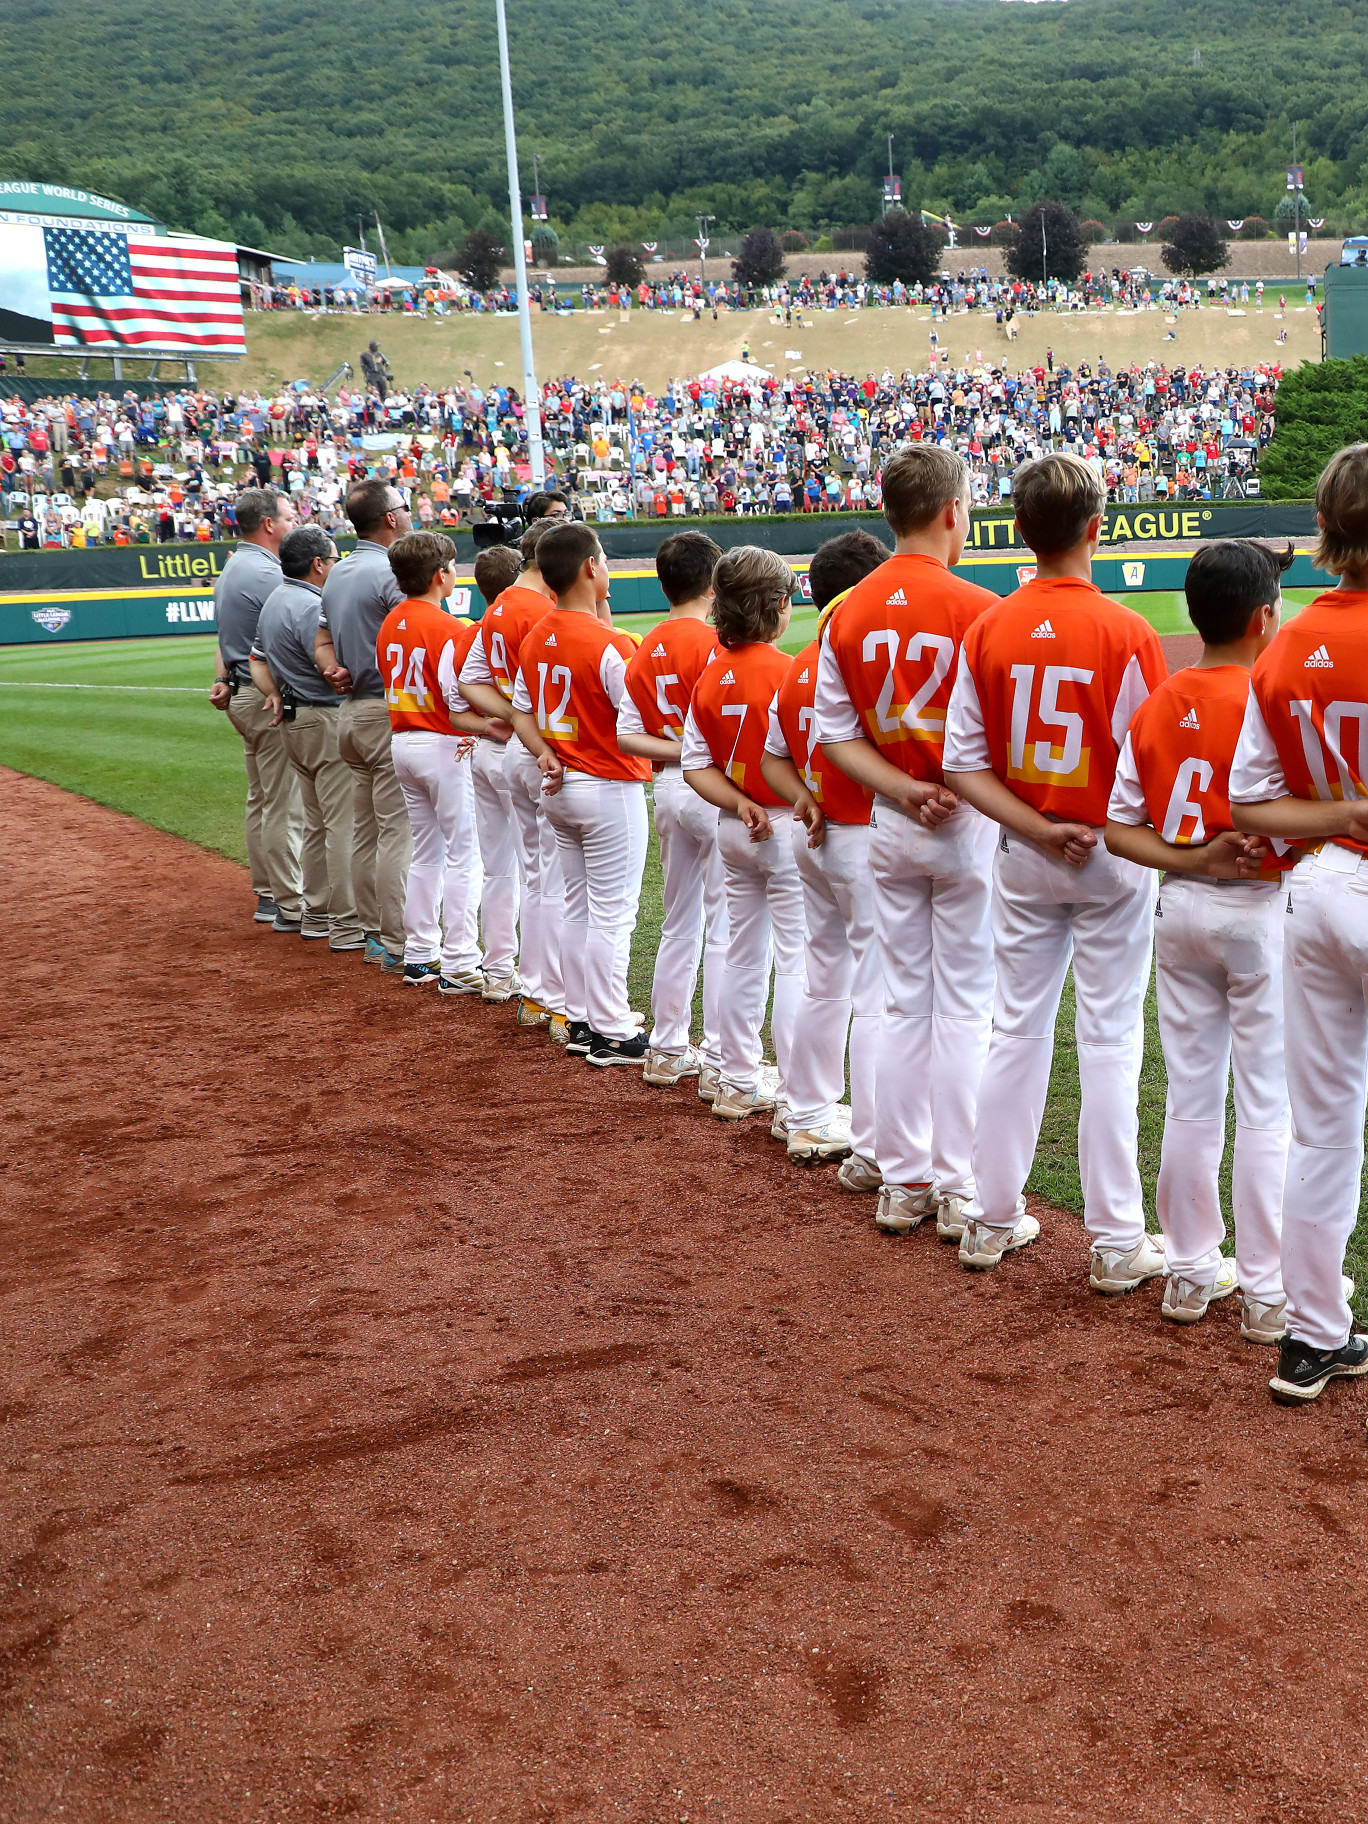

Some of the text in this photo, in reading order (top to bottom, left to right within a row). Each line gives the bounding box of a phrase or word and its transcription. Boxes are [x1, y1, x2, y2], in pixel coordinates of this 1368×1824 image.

[0, 182, 130, 218] EAGUE WORLD SERIES
[16, 214, 152, 234] FOUNDATIONS
[139, 552, 224, 579] LittleL
[1130, 566, 1138, 579] A
[166, 601, 215, 622] #LLW
[456, 592, 464, 606] J
[885, 598, 908, 606] adidas
[1030, 630, 1056, 639] adidas
[386, 643, 428, 706] 24
[490, 631, 514, 694] 9
[1303, 658, 1334, 668] adidas
[862, 629, 955, 733] 22
[537, 662, 573, 733] 12
[655, 673, 684, 742] 5
[1010, 664, 1095, 774] 15
[1179, 720, 1201, 730] adidas
[721, 704, 749, 778] 7
[1161, 757, 1214, 845] 6
